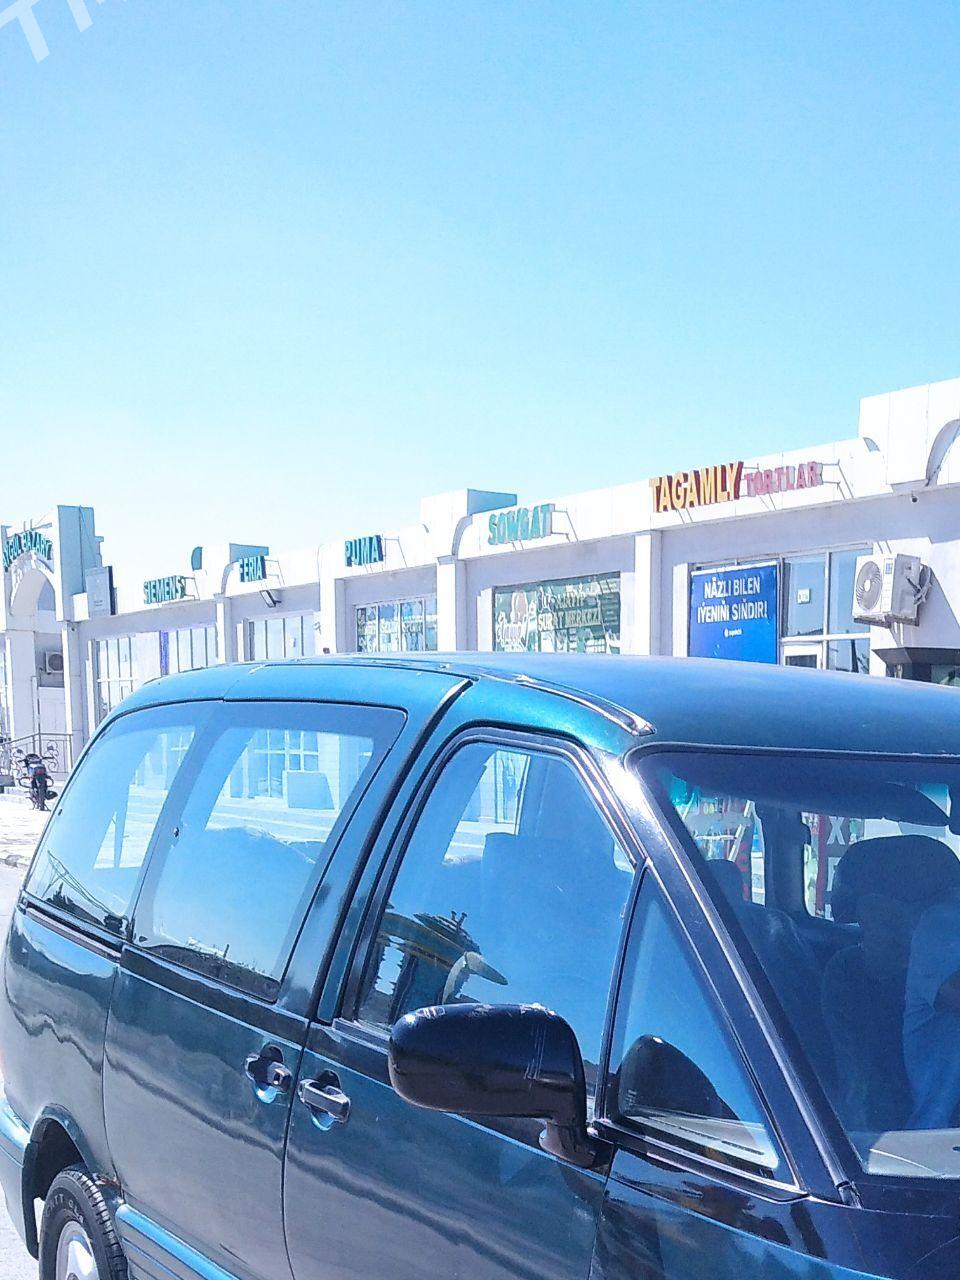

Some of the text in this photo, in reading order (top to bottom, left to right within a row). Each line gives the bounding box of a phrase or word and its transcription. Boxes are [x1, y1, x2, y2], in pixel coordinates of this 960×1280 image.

[649, 461, 743, 513] TAGAMLY
[345, 535, 383, 567] PUMA
[239, 556, 267, 582] FERIA
[143, 575, 186, 604] SIEMENS
[733, 577, 760, 596] BILEN
